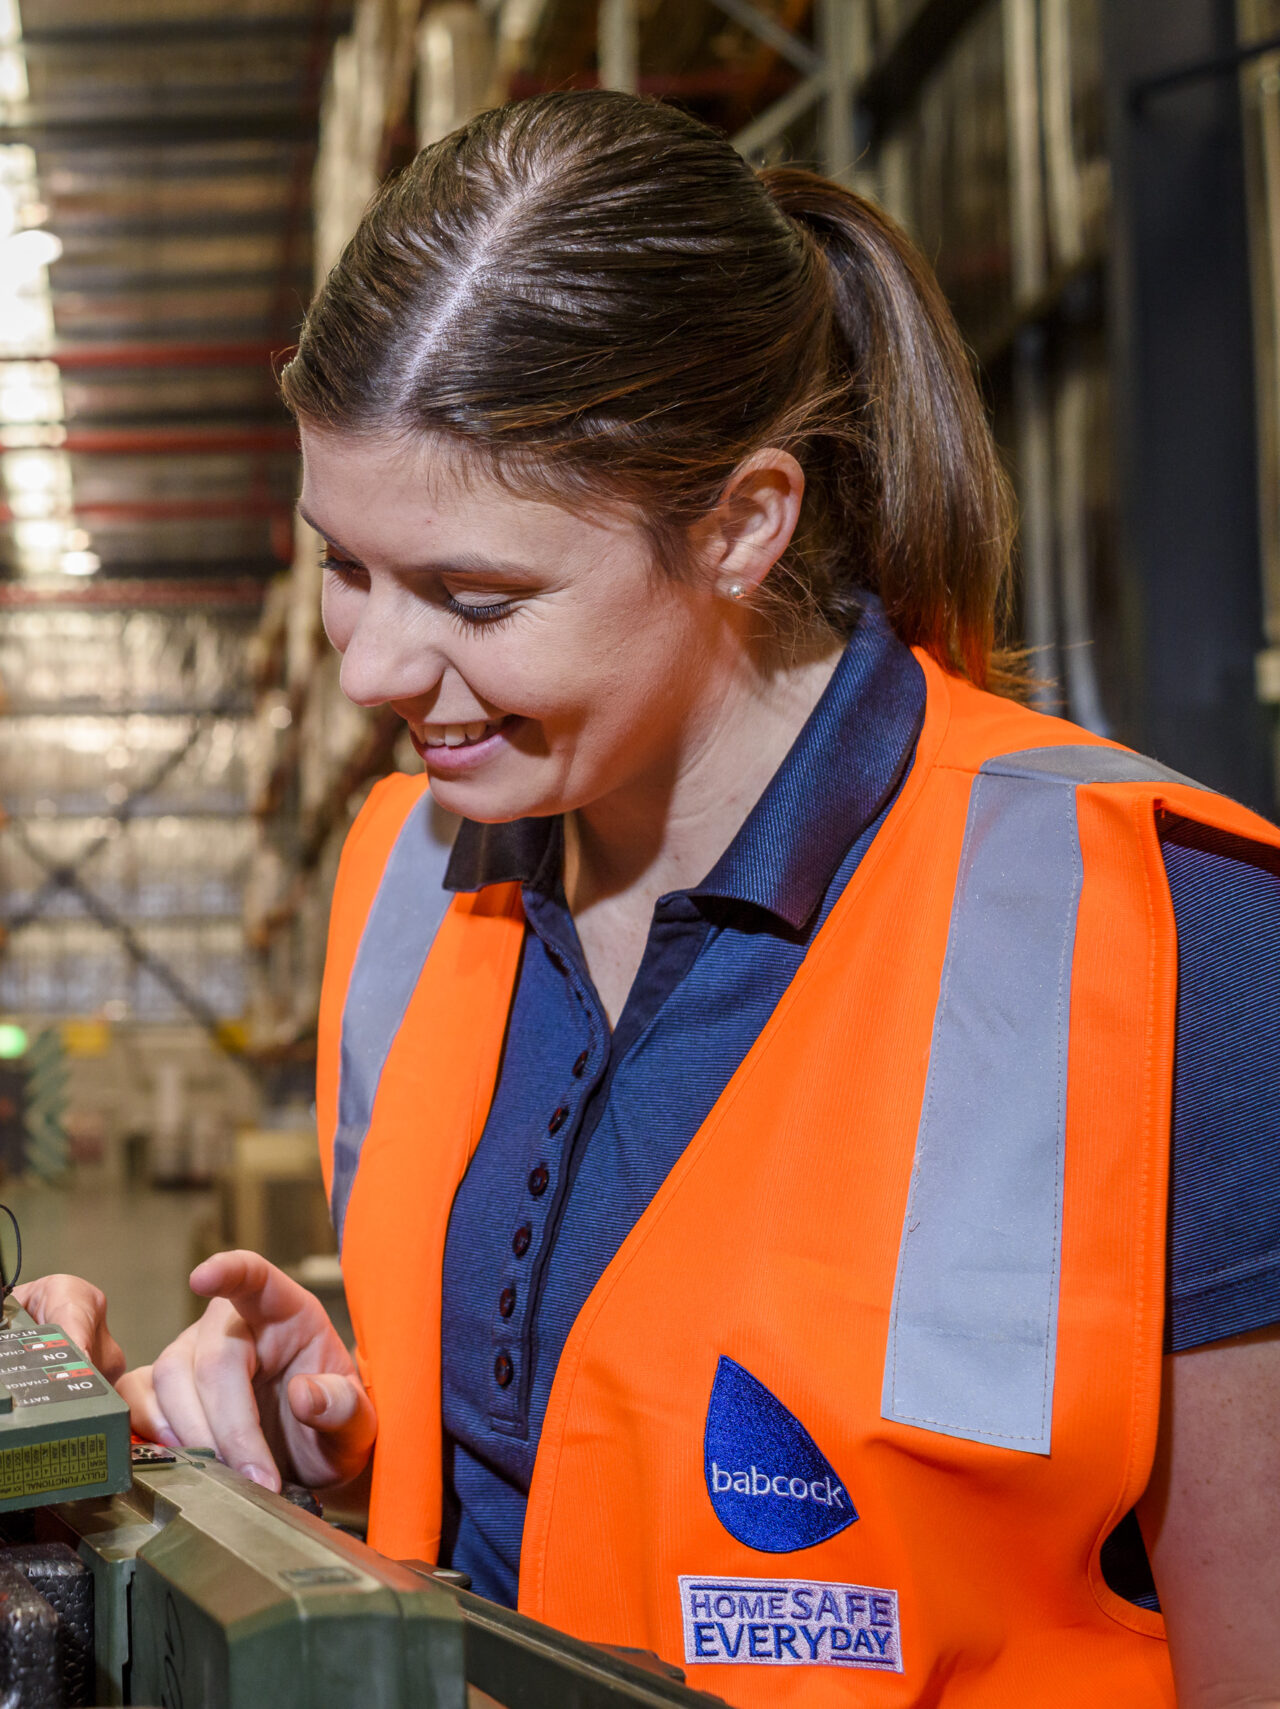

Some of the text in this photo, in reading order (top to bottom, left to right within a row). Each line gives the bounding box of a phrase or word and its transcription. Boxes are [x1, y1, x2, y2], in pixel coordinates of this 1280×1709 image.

[43, 1352, 68, 1361] ON
[6, 1378, 49, 1390] CHARGE
[67, 1381, 93, 1391] ON
[26, 1471, 106, 1490] FULLY FUNCTIONAL
[711, 1462, 844, 1509] babcock
